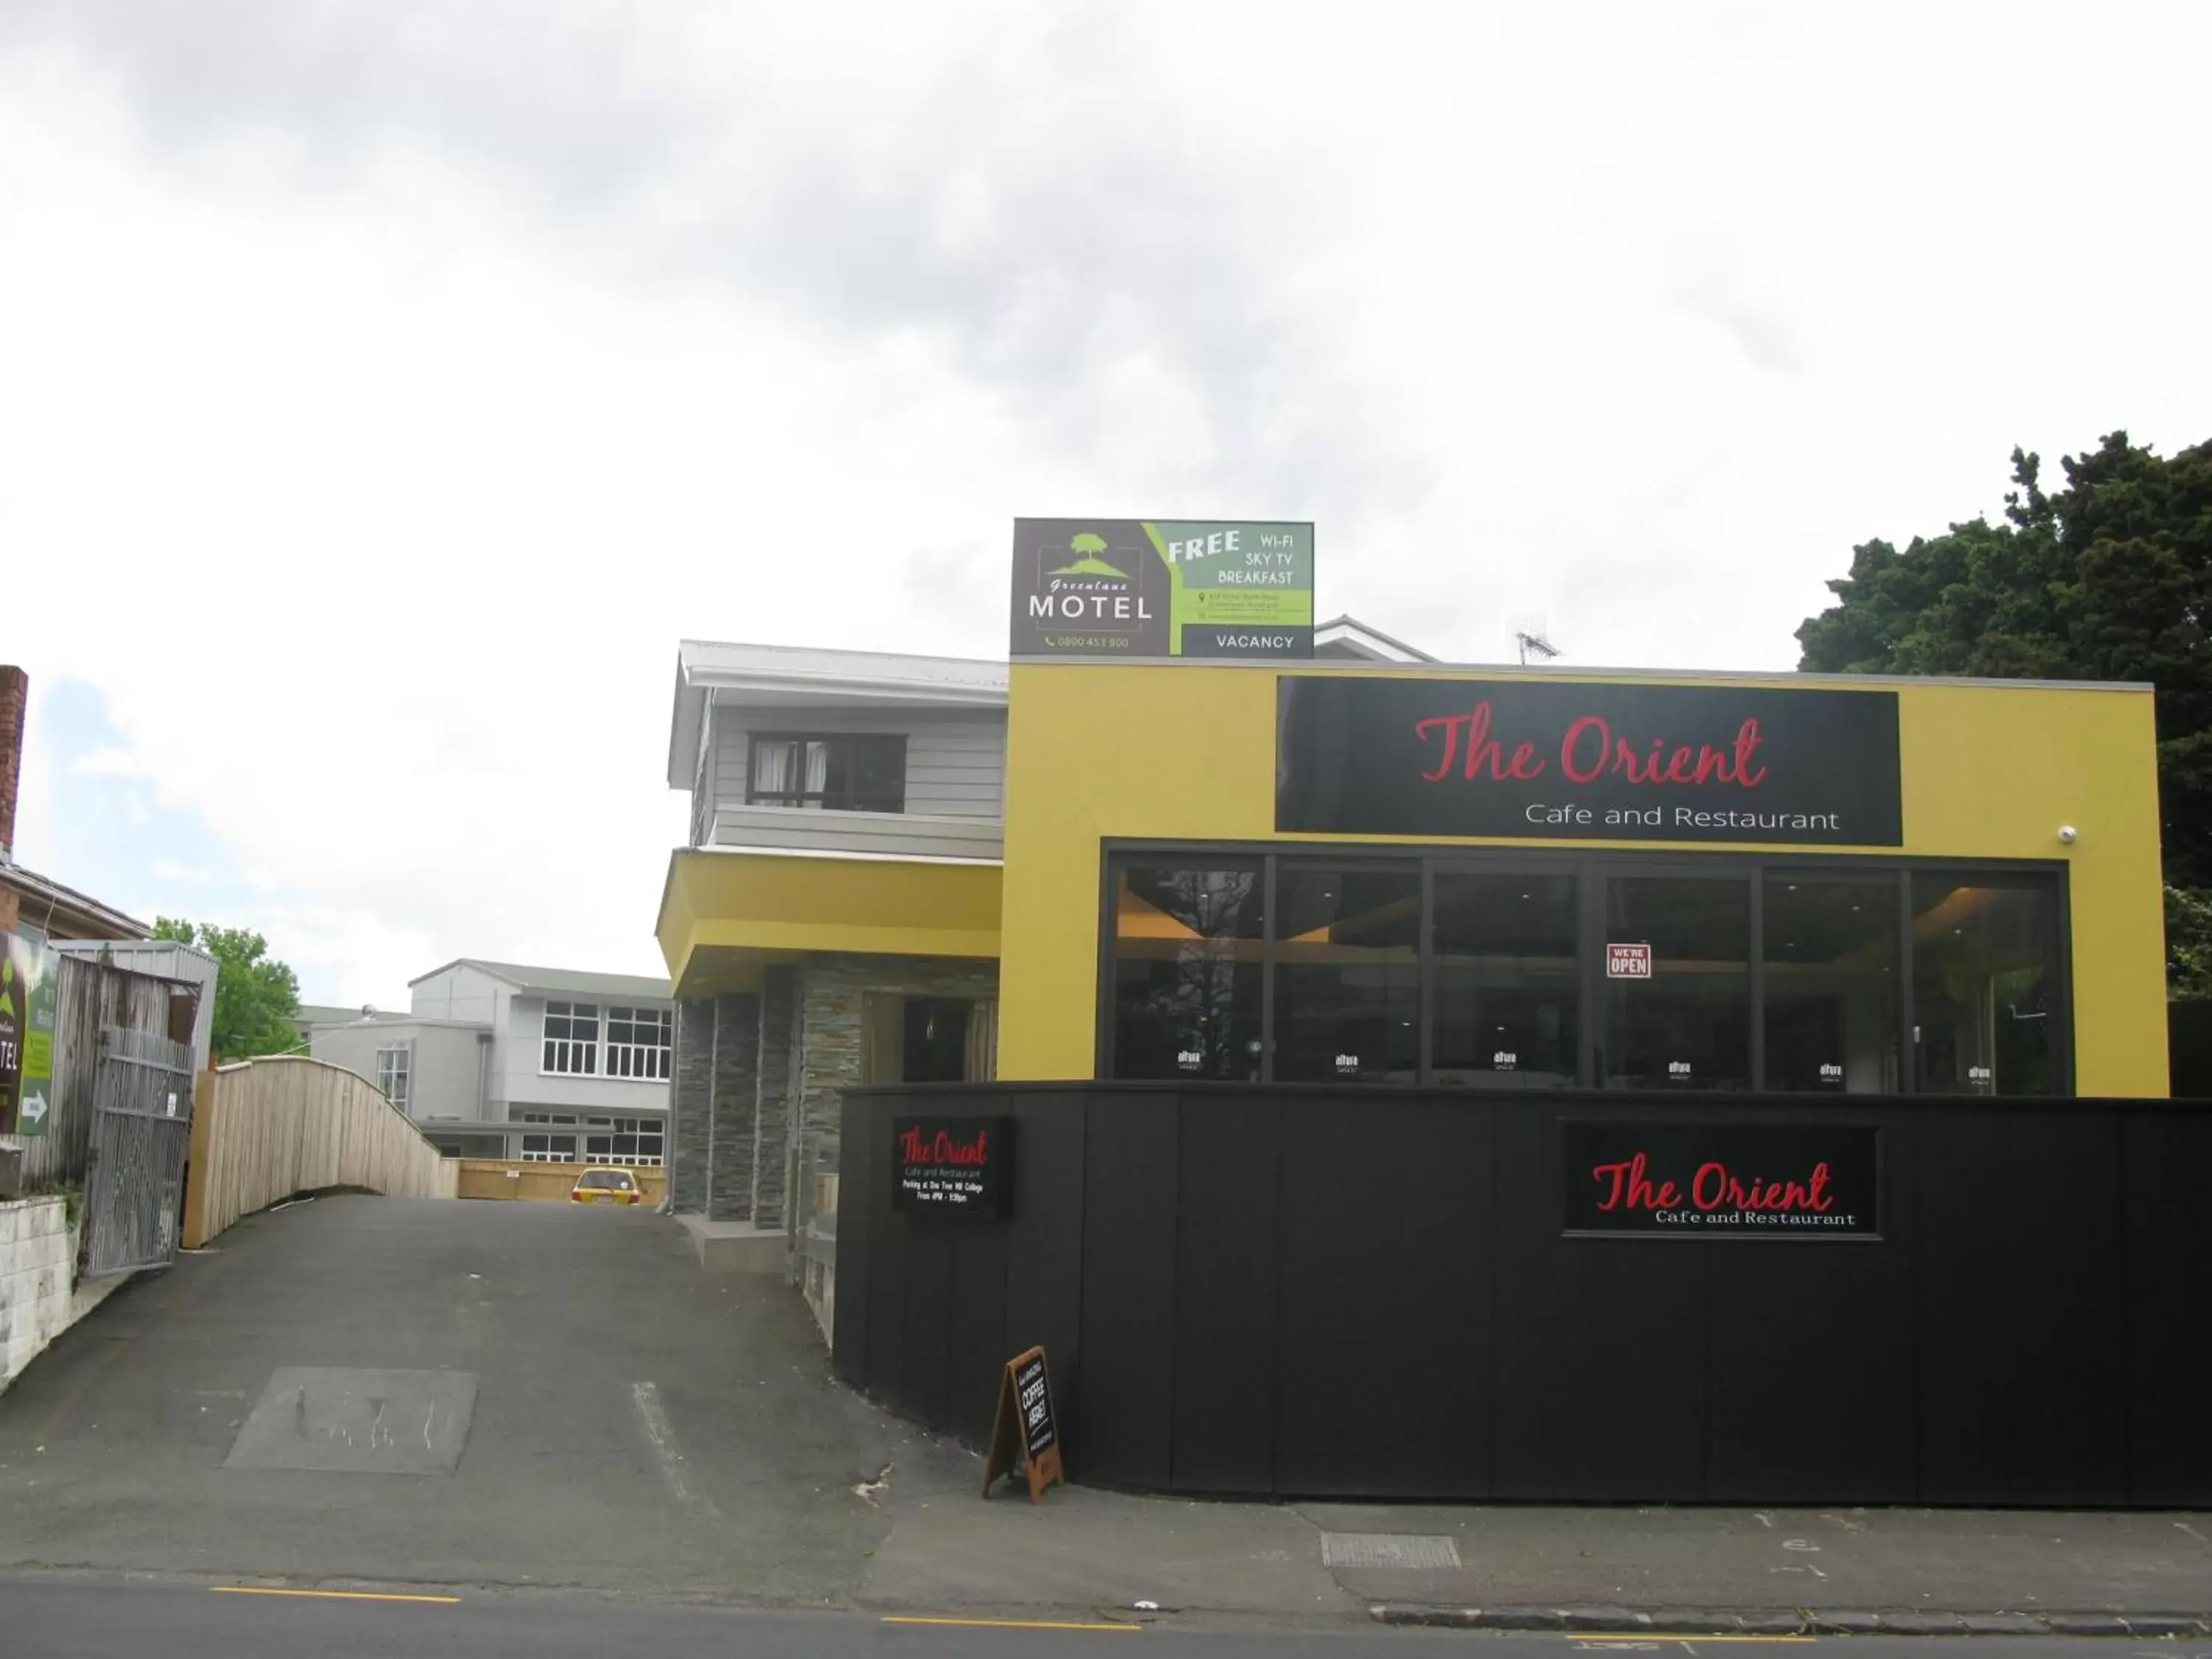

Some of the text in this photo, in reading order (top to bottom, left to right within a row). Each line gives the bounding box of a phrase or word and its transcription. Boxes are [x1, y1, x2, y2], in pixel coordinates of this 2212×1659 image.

[1169, 530, 1293, 563] FREE WI-FI
[1245, 553, 1293, 566] SKY TV
[1218, 570, 1294, 585] BREAKFAST
[1029, 595, 1152, 619] MOTEL
[1217, 635, 1295, 648] VACANCY
[1415, 700, 1767, 787] The Orient
[1526, 804, 1840, 830] Cafe and Restaurant
[1611, 958, 1646, 973] OPEN
[900, 1124, 987, 1165] The Orient
[1593, 1152, 1833, 1211] The Orient
[1655, 1211, 1856, 1225] Cafe and Restaurant
